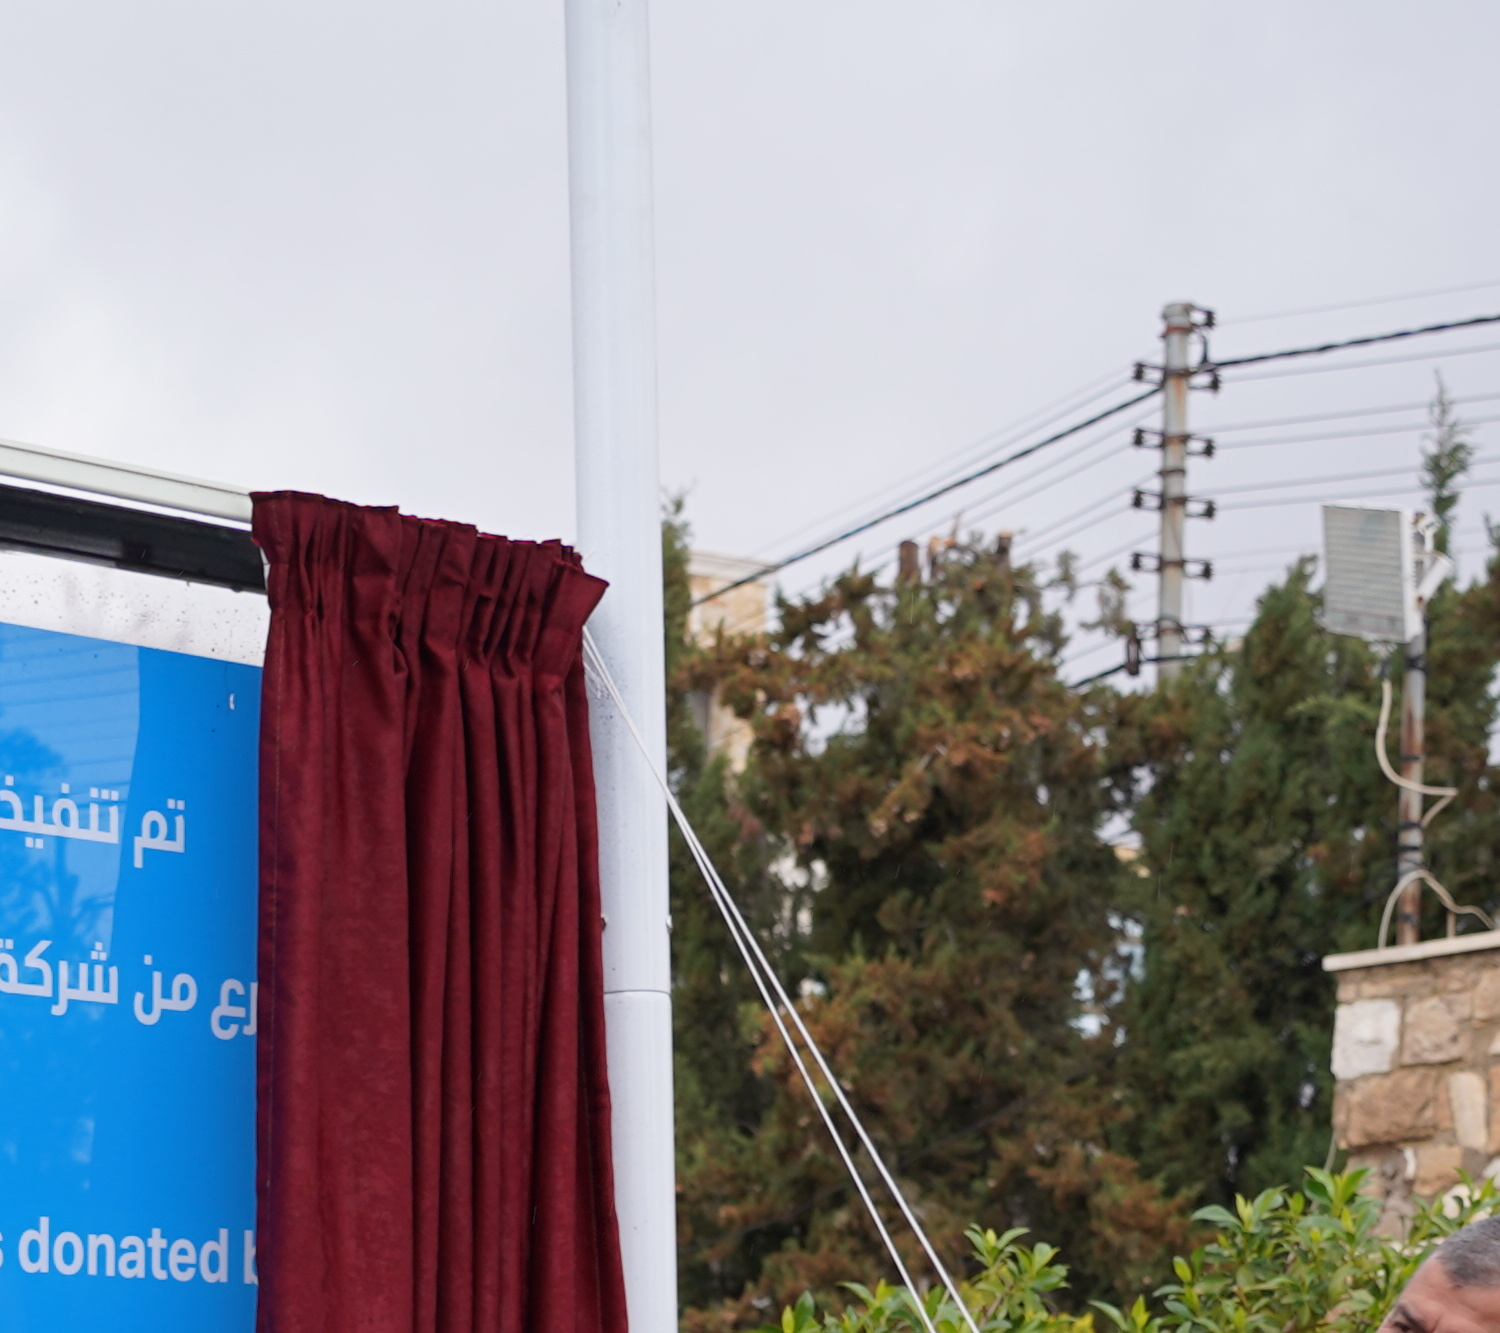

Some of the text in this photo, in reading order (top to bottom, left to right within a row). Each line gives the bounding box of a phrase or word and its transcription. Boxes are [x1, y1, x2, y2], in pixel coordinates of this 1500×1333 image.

[133, 797, 186, 869] تم
[132, 953, 199, 1026] من
[17, 1215, 229, 1284] donated
